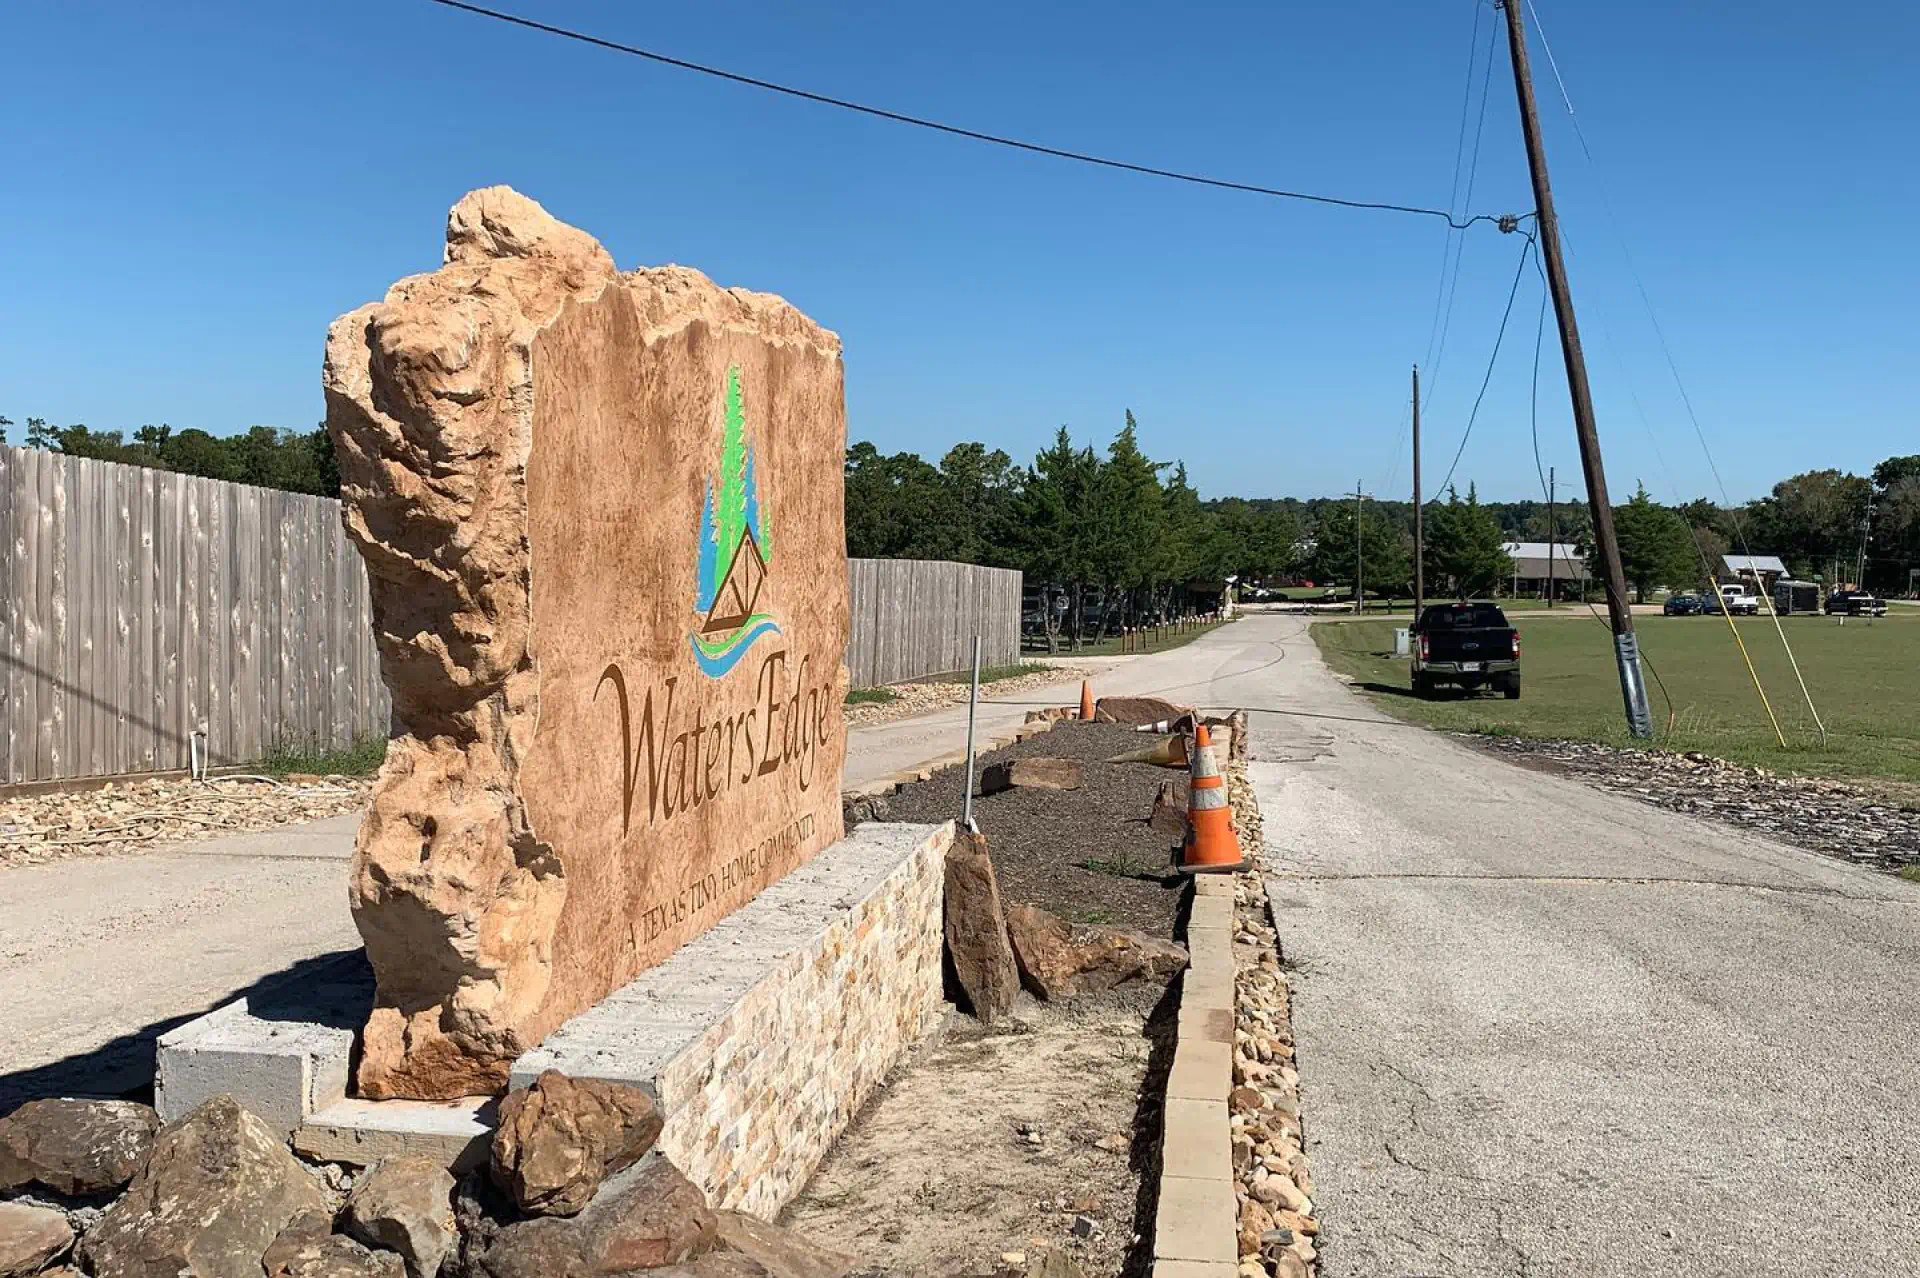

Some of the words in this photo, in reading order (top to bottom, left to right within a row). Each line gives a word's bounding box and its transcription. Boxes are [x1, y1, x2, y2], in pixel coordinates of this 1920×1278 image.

[627, 921, 637, 950] A
[641, 890, 686, 945] TEXAS
[689, 872, 717, 915] TINY
[721, 847, 757, 893] HOME
[758, 813, 816, 869] COMMUNITY
